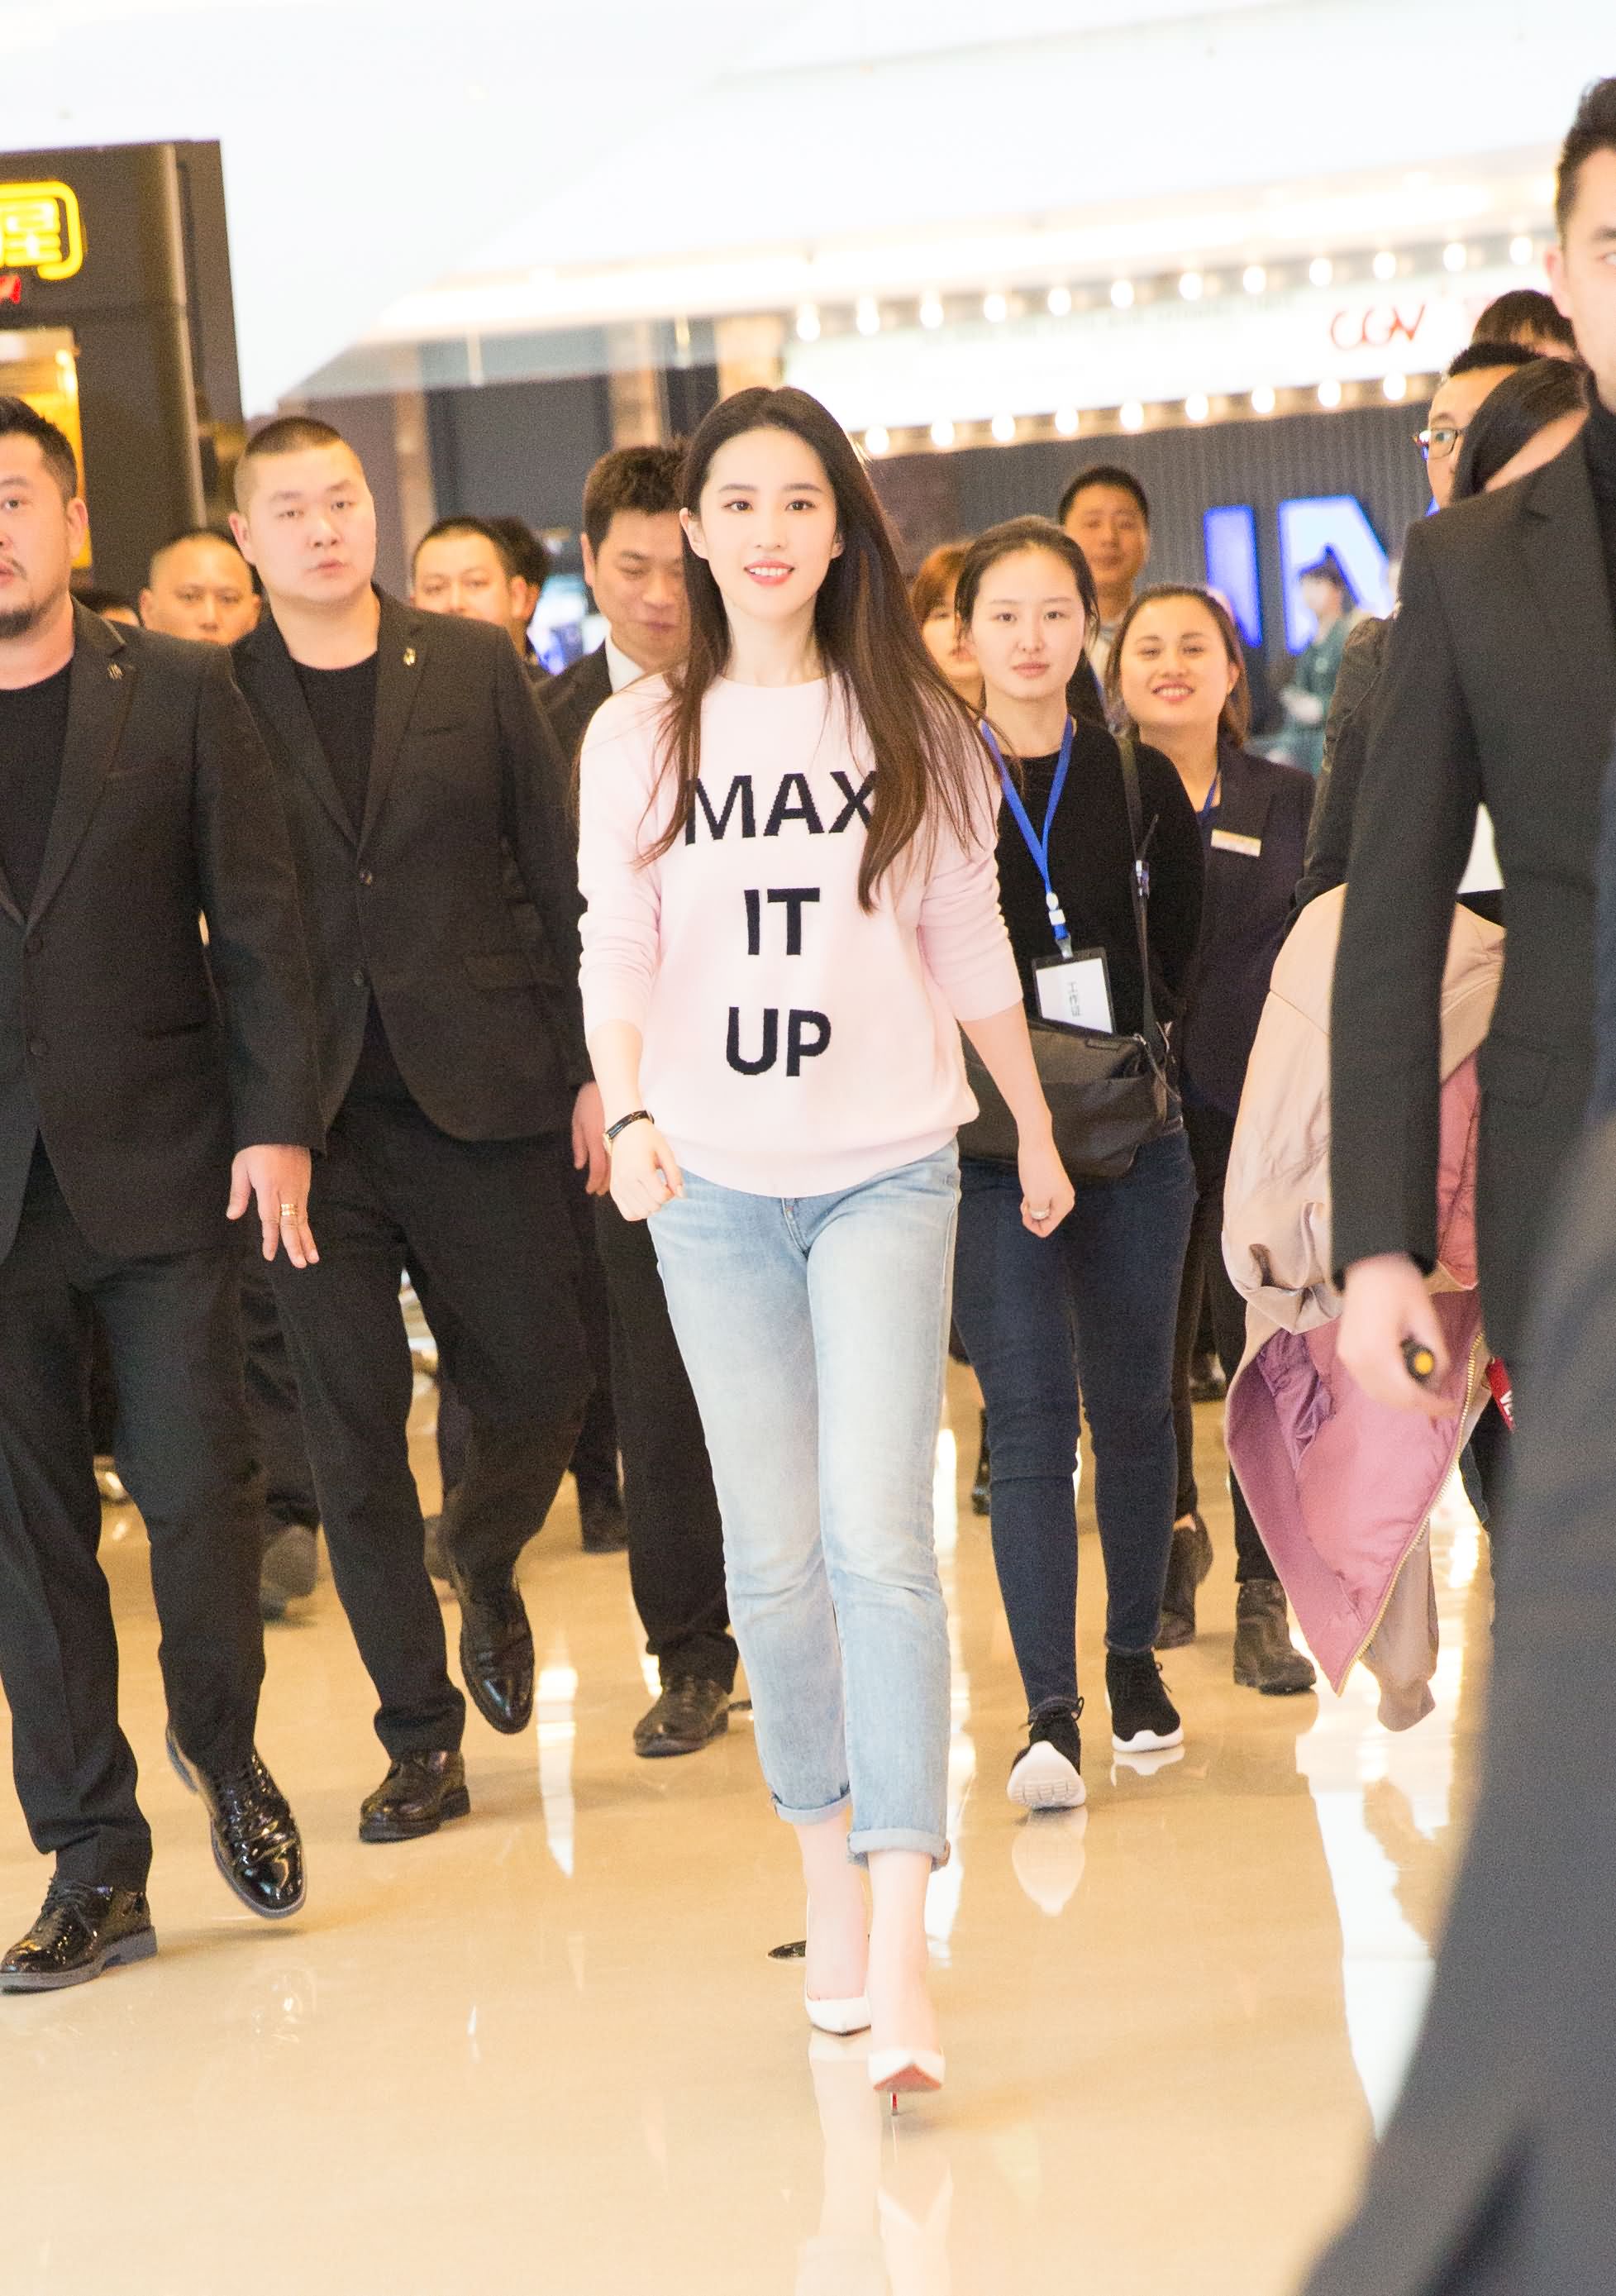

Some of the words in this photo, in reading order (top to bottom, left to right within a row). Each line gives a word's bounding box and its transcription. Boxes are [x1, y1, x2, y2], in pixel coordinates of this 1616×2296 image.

[684, 771, 877, 846] MAX
[744, 886, 821, 957] IT
[725, 1005, 832, 1077] UP
